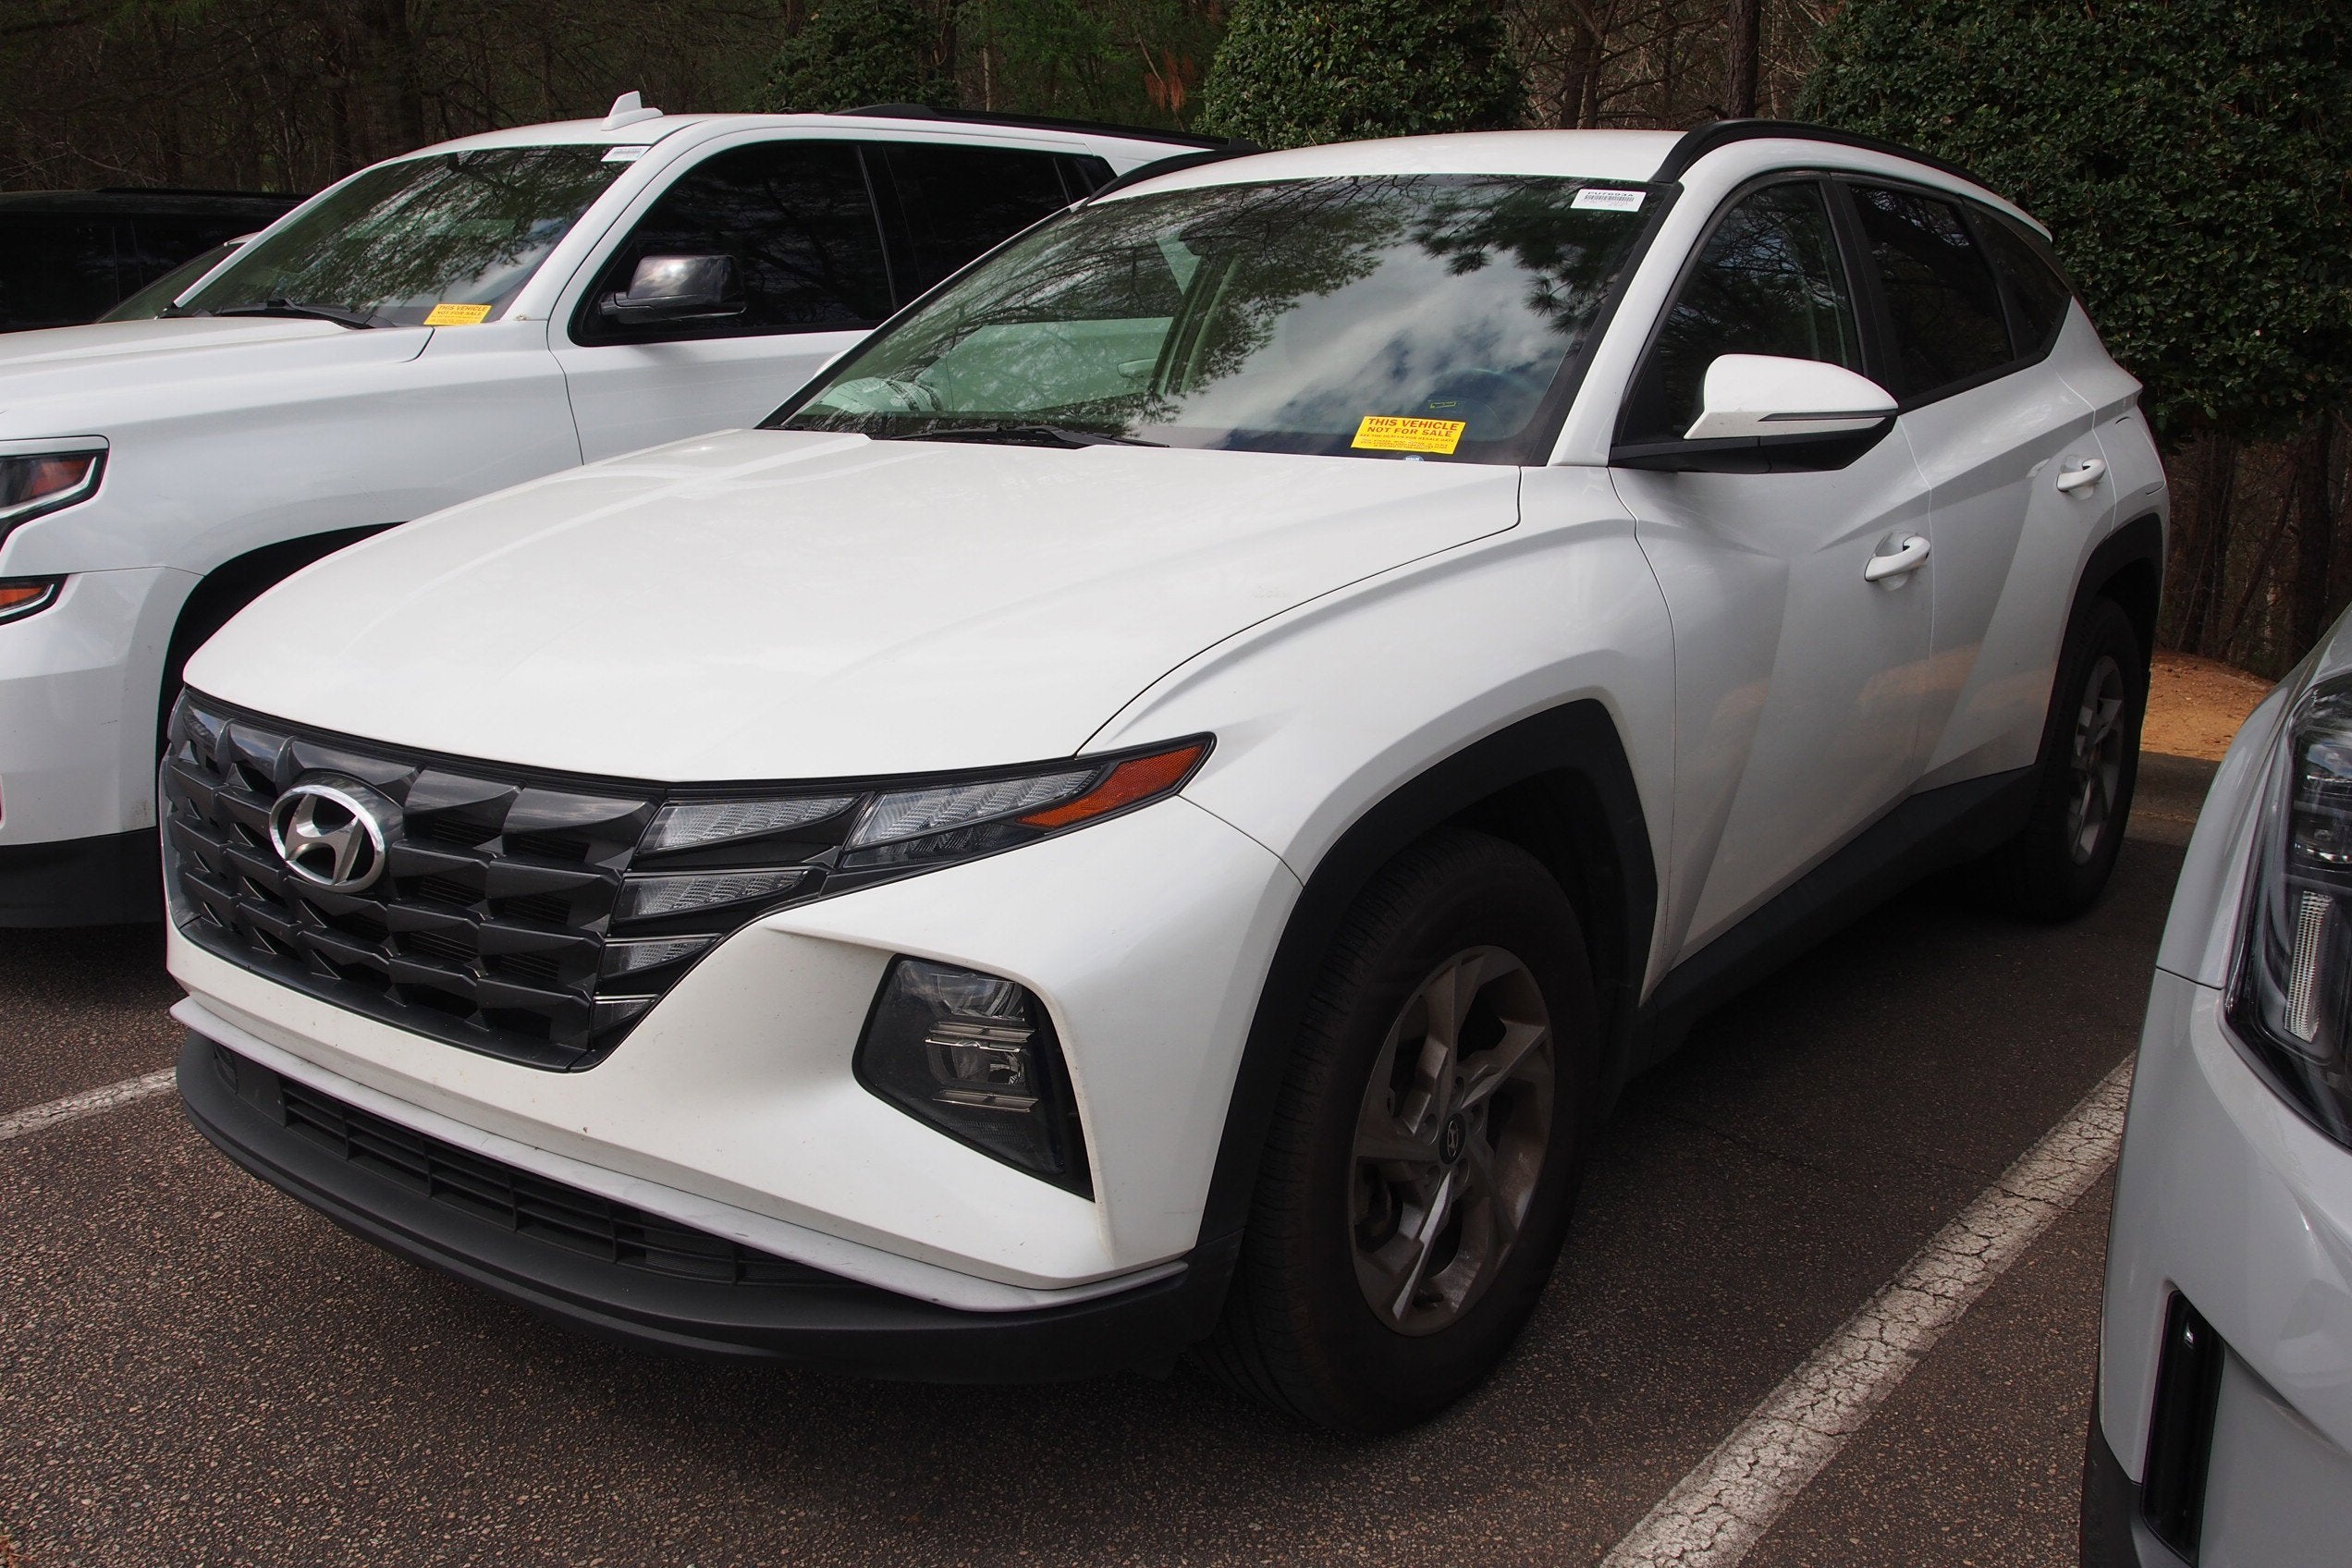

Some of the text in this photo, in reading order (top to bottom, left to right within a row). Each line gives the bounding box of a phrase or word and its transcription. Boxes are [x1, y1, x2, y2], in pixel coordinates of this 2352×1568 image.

[1368, 418, 1459, 431] THIS VEHICLE
[1393, 427, 1418, 435] FOR
[1421, 429, 1453, 437] SALE
